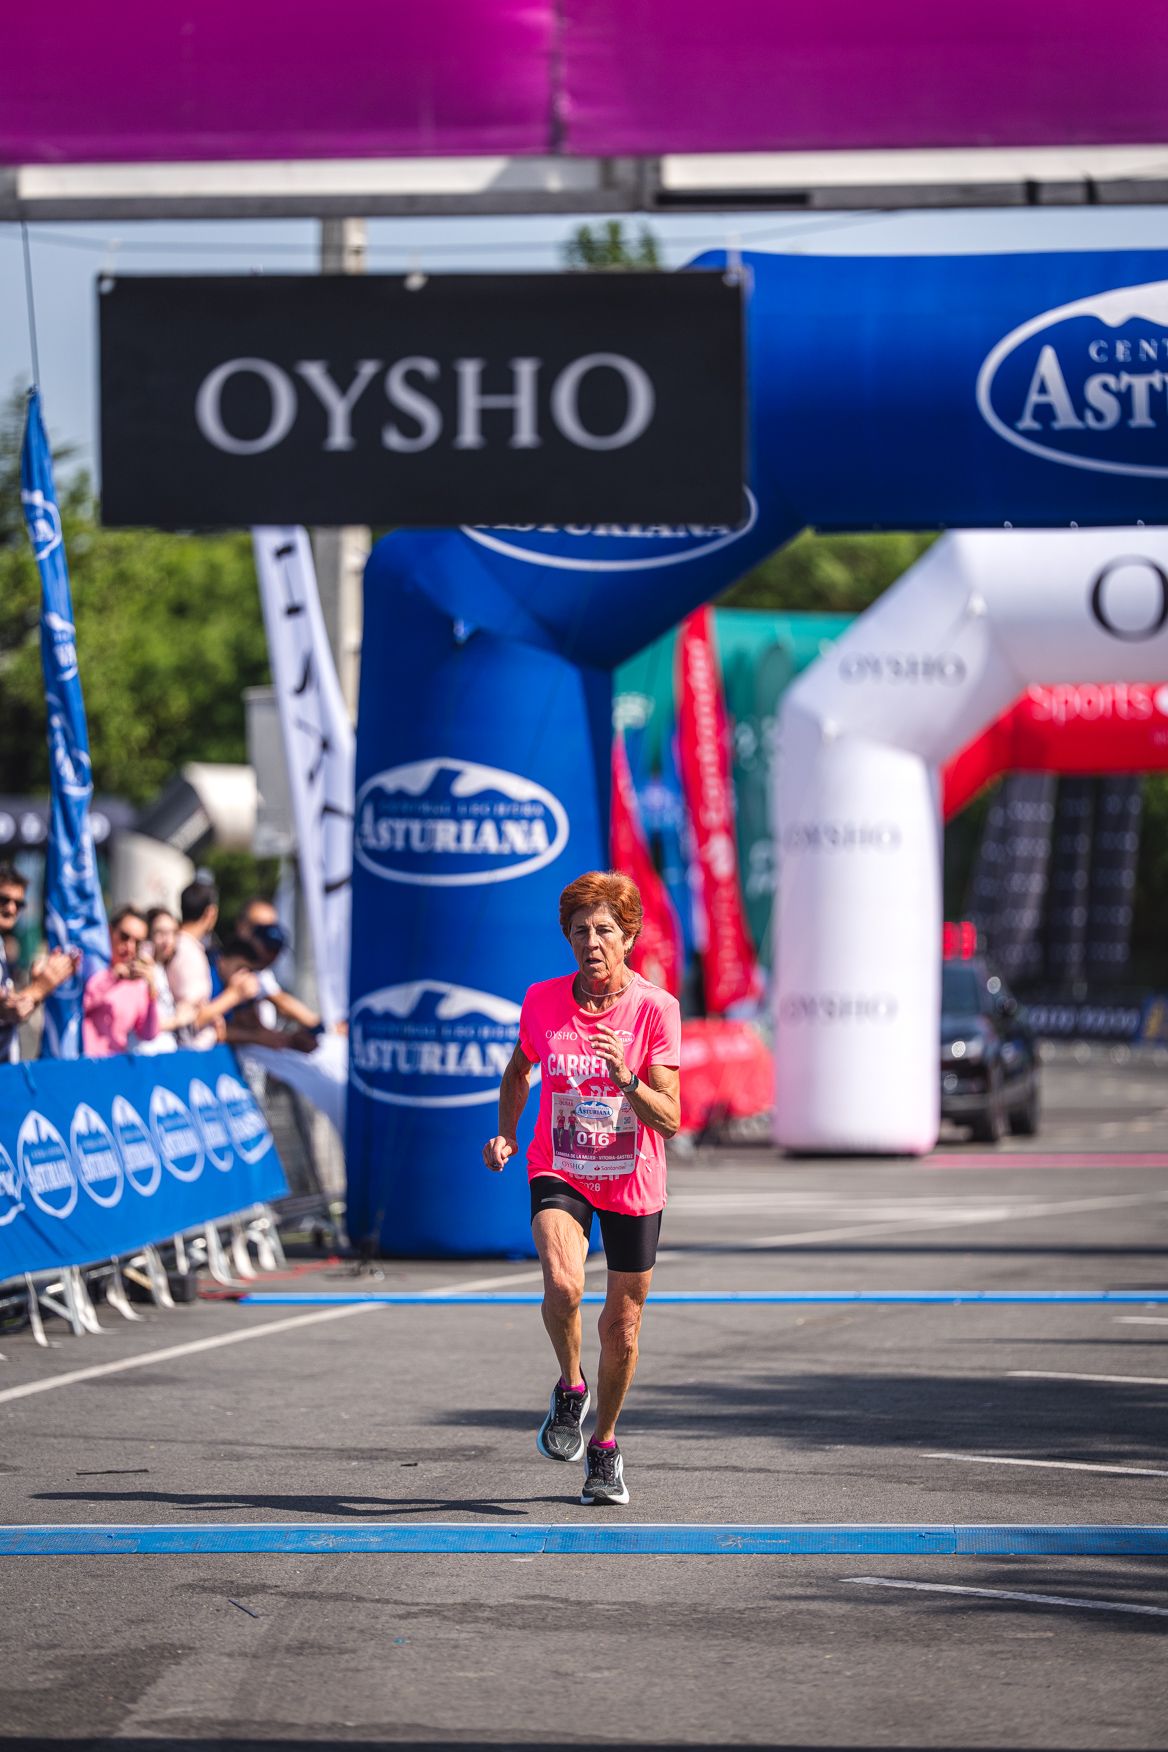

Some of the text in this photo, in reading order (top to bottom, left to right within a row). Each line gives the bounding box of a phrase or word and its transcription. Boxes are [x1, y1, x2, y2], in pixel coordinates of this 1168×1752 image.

[1015, 344, 1168, 431] AST
[195, 352, 655, 455] OYSHO
[359, 802, 550, 855] ASTURIANA
[545, 1029, 578, 1041] OYSHO
[352, 1023, 517, 1077] ASTURIAN
[547, 1053, 610, 1078] CARRER
[577, 1106, 611, 1116] ASTURIANA
[577, 1131, 610, 1146] 016
[561, 1161, 584, 1170] OYSHO
